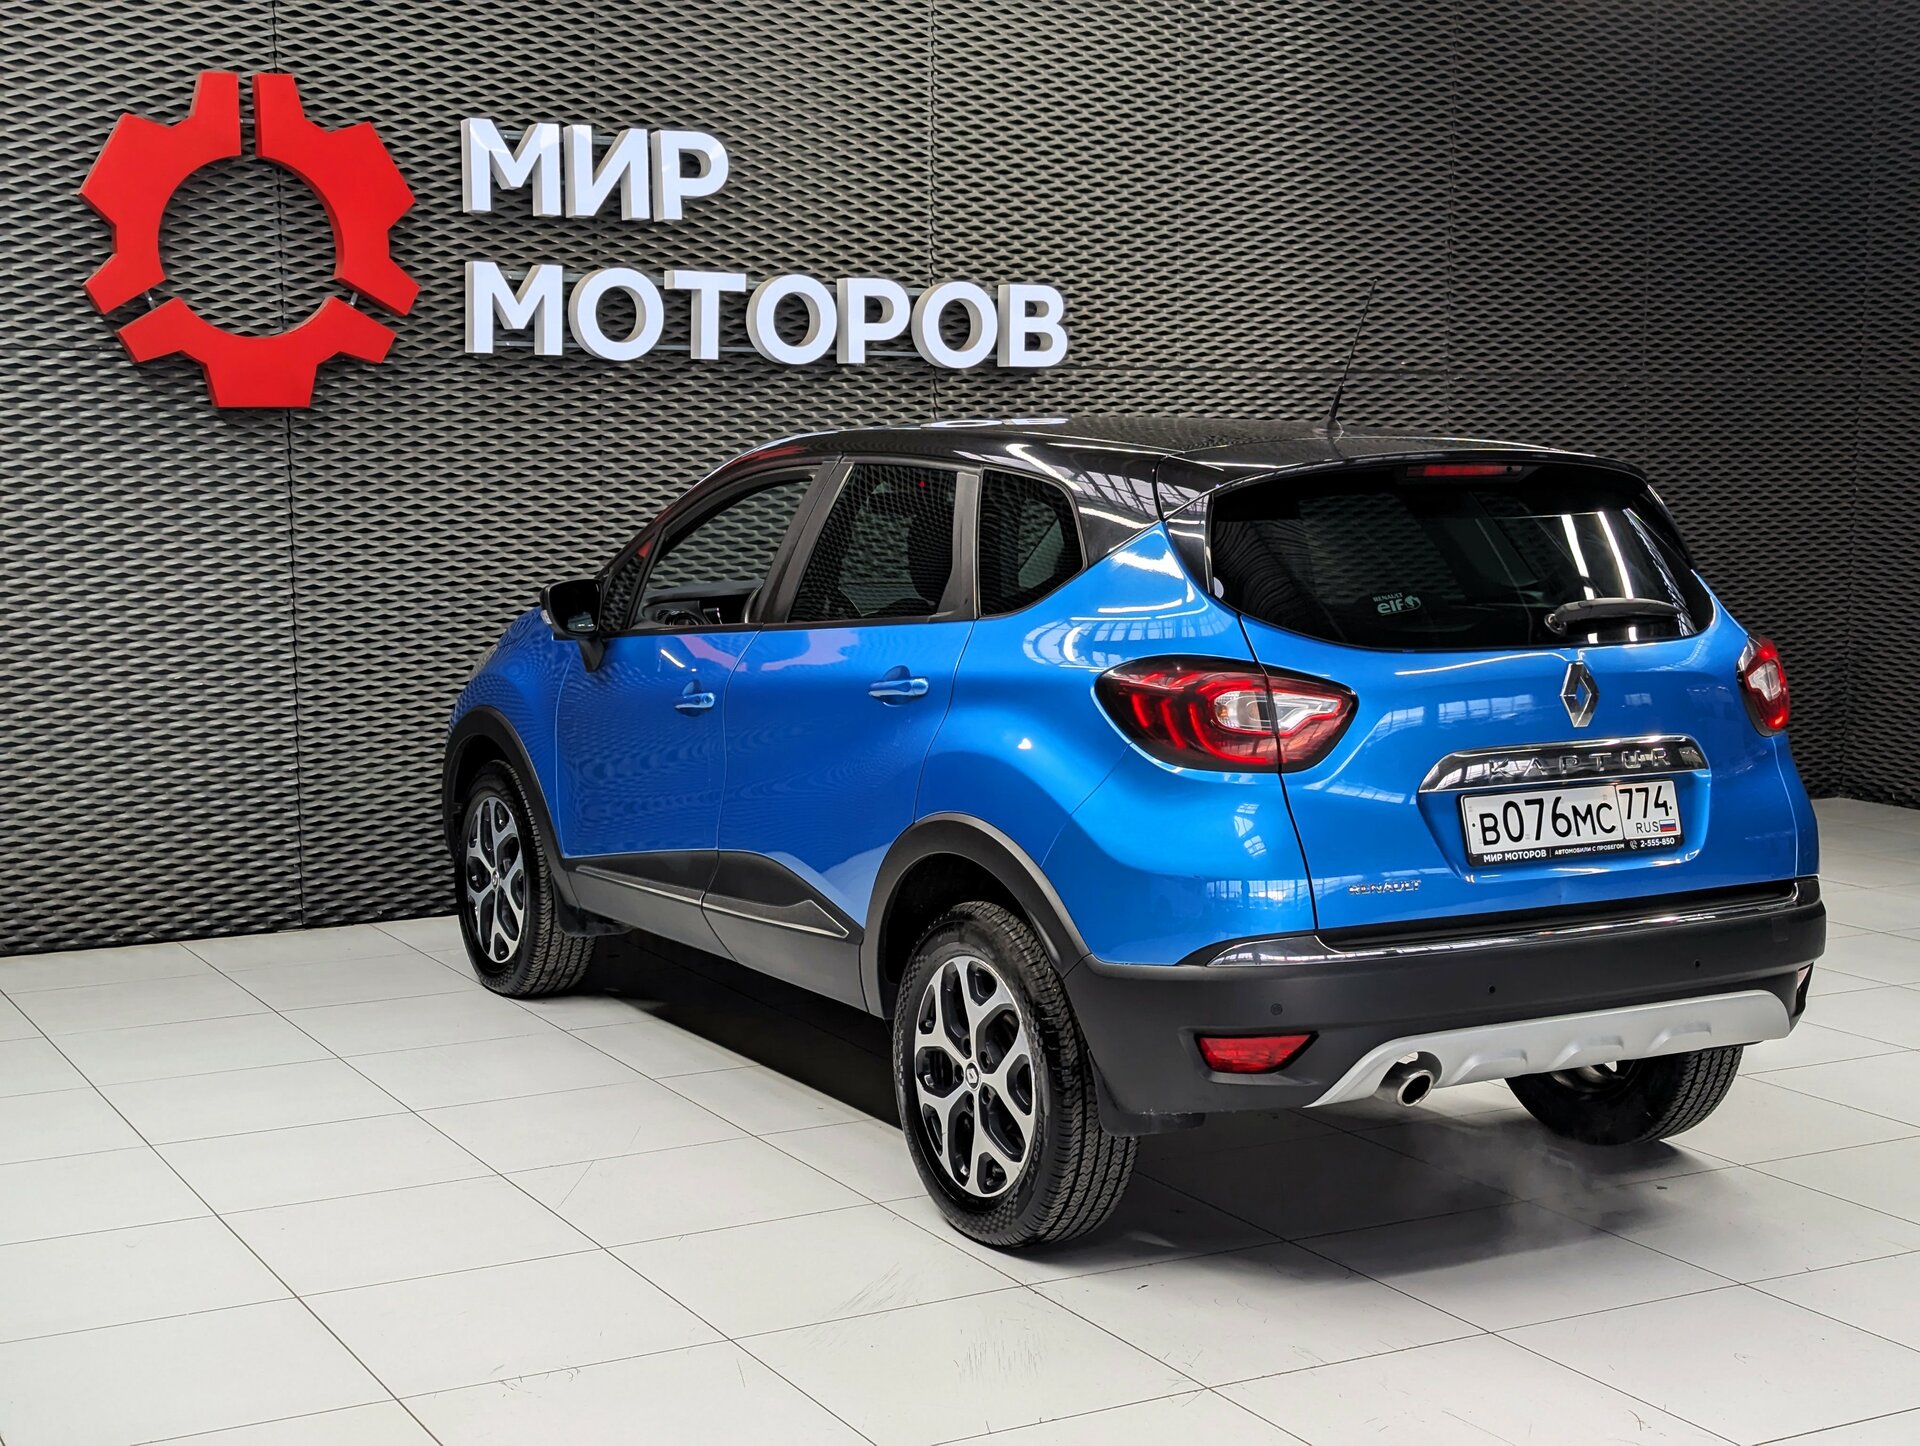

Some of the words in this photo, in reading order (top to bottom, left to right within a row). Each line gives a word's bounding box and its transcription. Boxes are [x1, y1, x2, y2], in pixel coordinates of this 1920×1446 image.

[460, 117, 730, 222] МИР
[464, 260, 1069, 369] МОТОРОВ
[1377, 598, 1404, 613] elf
[1489, 747, 1671, 778] KAPTUR
[1618, 785, 1670, 820] 774
[1636, 820, 1660, 834] RUS
[1483, 853, 1503, 863] МИР
[1504, 849, 1547, 861] МОТОРОВ
[1554, 847, 1592, 856] АВТОМОБИЛИ
[1597, 843, 1625, 852] ПРОБЕГОМ
[1640, 837, 1676, 848] 2-555-850
[1348, 880, 1421, 896] RENAULT
